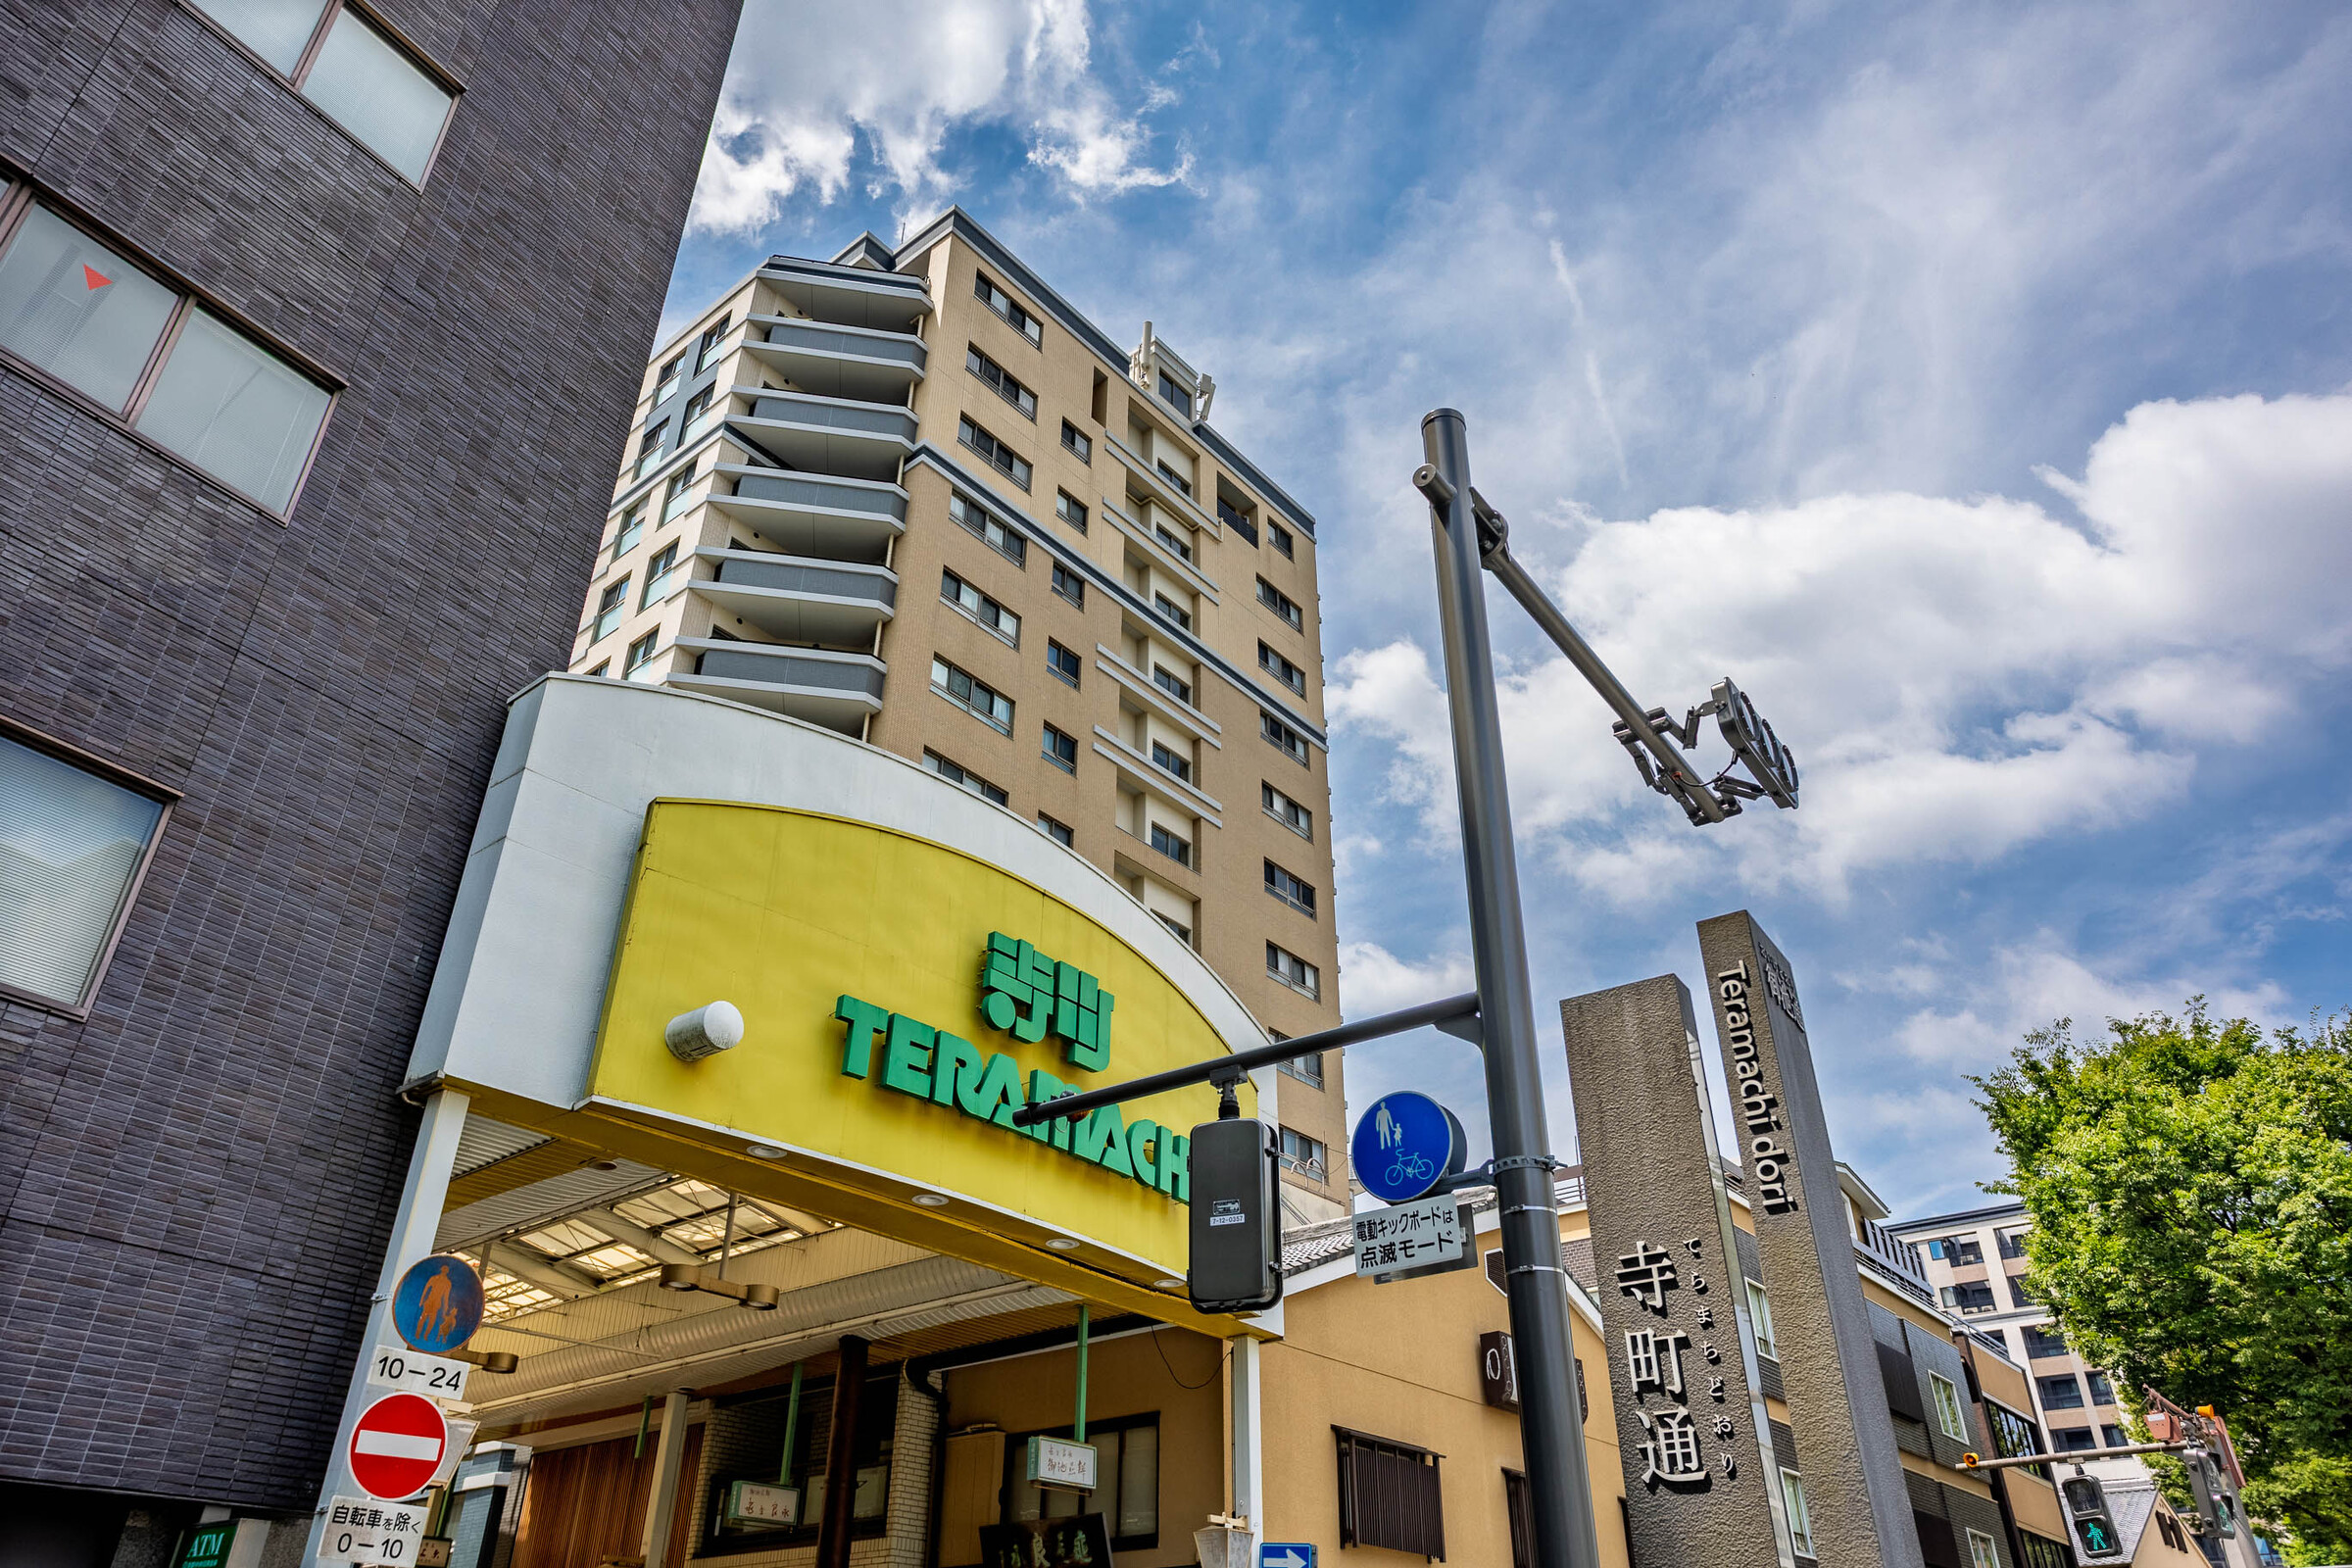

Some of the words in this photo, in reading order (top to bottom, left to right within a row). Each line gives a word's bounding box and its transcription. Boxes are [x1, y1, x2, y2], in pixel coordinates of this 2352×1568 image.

[834, 994, 1190, 1206] TERAMACH
[1717, 959, 1778, 1126] Teramachi
[1751, 1136, 1794, 1206] dori
[1355, 1205, 1454, 1243] 電動キックボードは
[1360, 1230, 1454, 1269] 点滅モード
[377, 1355, 463, 1392] 10-24
[1614, 1240, 1709, 1484] 寺町通
[1683, 1237, 1735, 1473] てらまちどおり
[331, 1503, 421, 1535] 自転車を除く
[186, 1532, 225, 1559] ATM
[336, 1533, 404, 1560] 0-10
